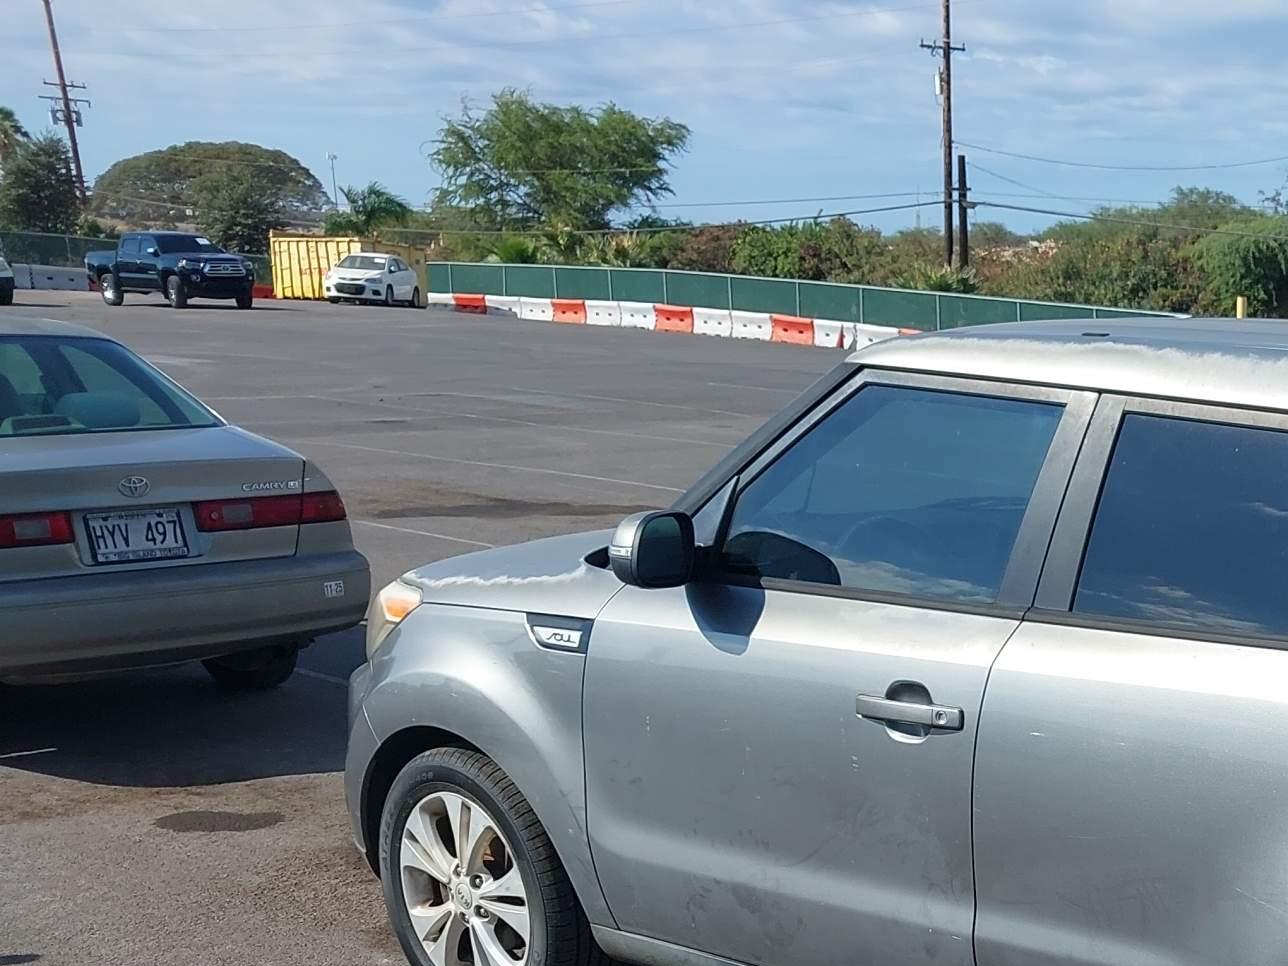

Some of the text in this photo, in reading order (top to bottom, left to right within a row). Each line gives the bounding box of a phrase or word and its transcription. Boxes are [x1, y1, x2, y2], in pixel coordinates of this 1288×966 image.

[241, 481, 286, 492] CAMRY
[92, 520, 180, 550] HYV 497
